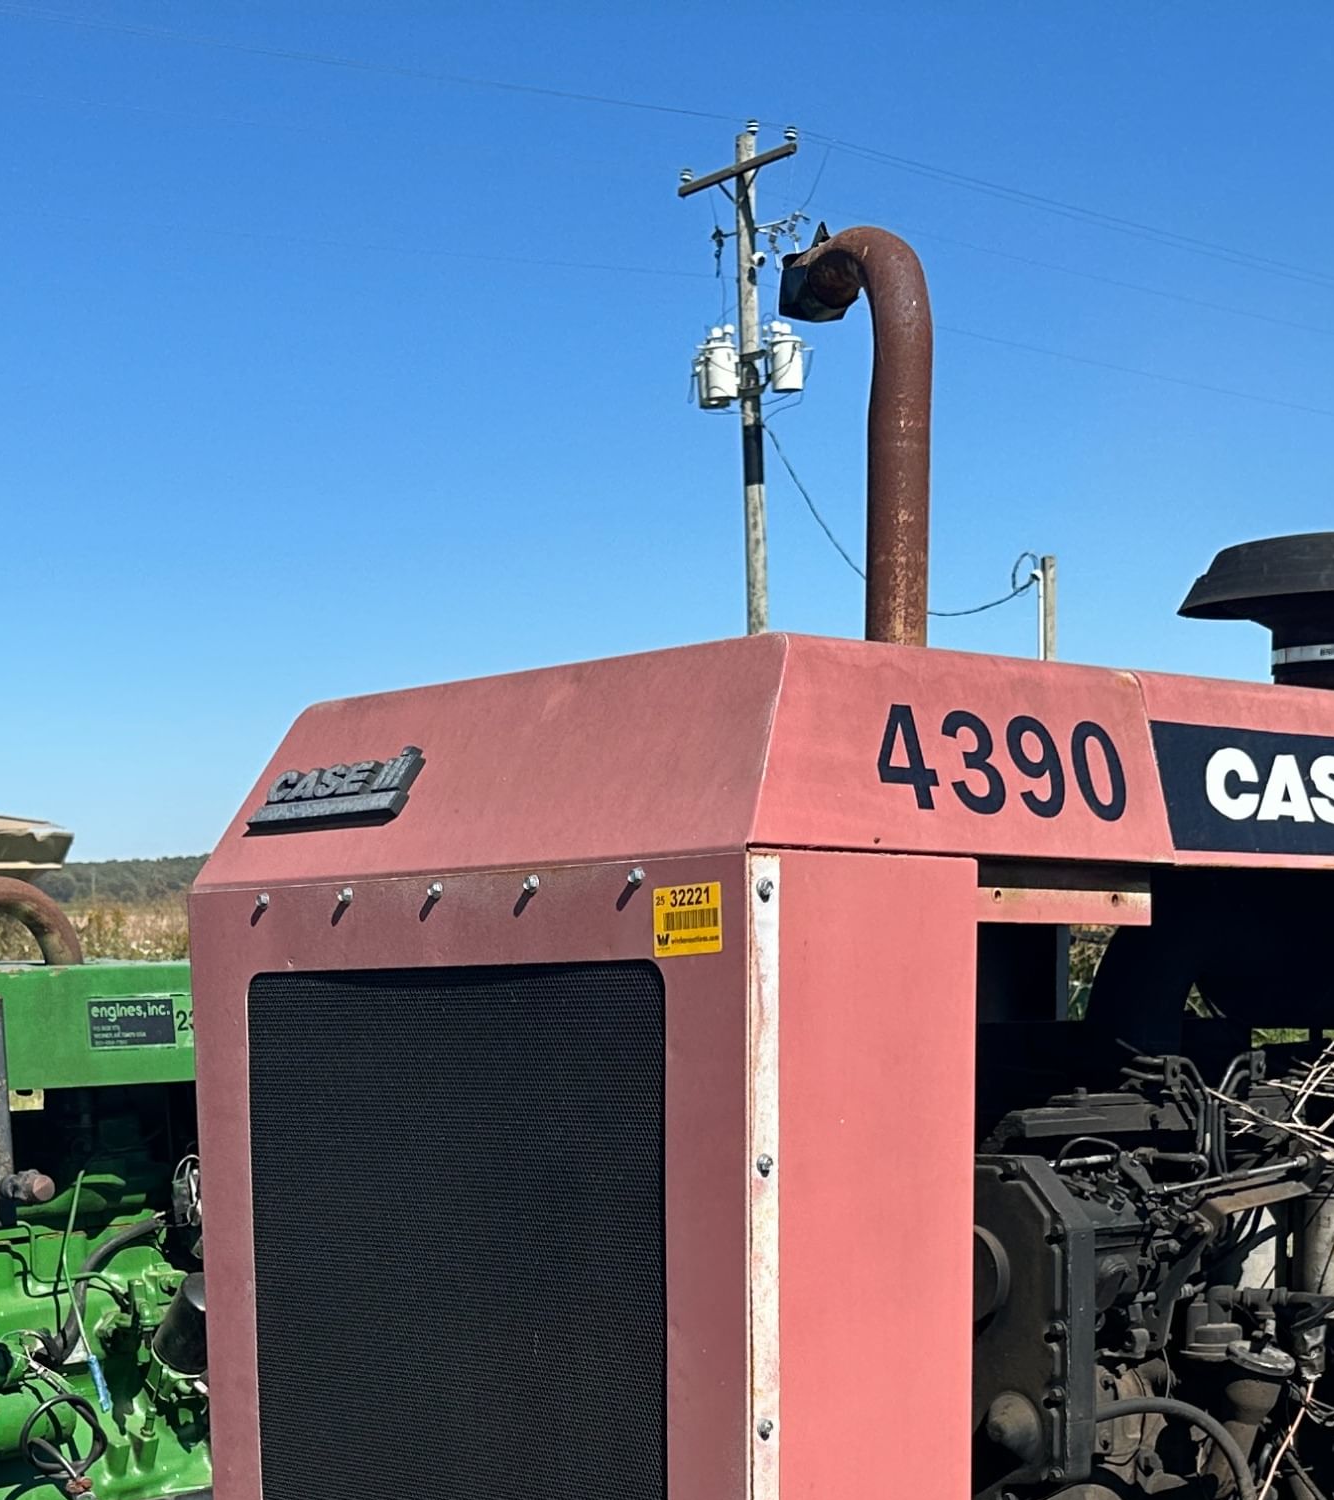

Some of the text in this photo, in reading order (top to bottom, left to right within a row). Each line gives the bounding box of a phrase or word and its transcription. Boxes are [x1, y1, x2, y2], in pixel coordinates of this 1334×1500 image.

[267, 759, 377, 803] CASE
[877, 703, 1127, 822] 4390
[669, 885, 710, 908] 32221
